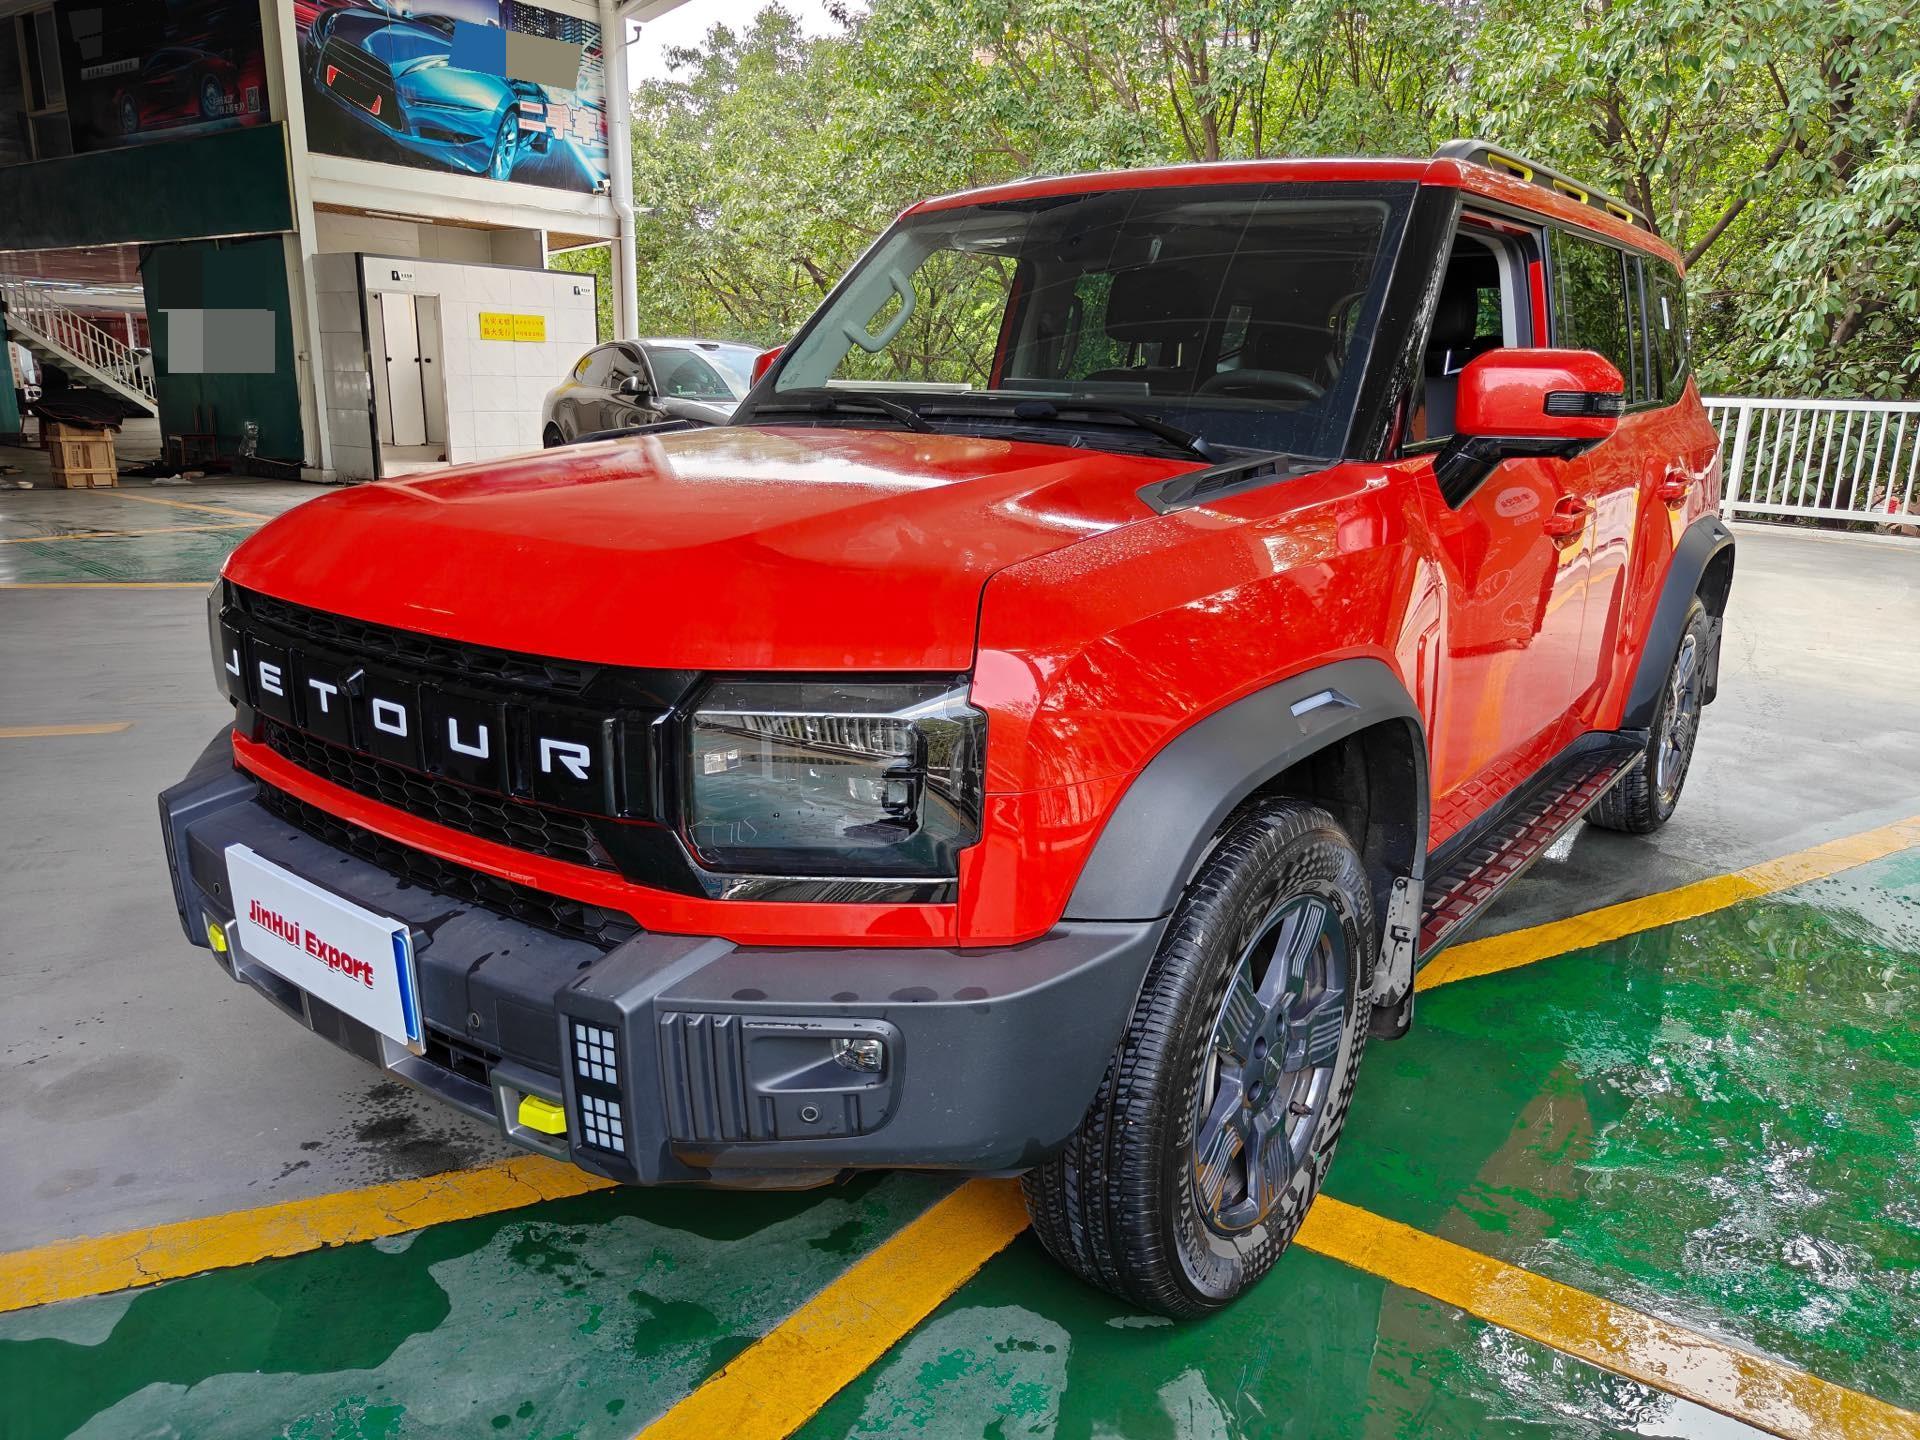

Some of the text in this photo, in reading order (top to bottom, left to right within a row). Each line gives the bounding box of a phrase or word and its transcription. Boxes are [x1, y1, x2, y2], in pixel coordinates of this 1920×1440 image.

[519, 100, 598, 145] 二手车
[226, 649, 591, 780] JETOUR
[249, 899, 374, 989] JinHui Export
